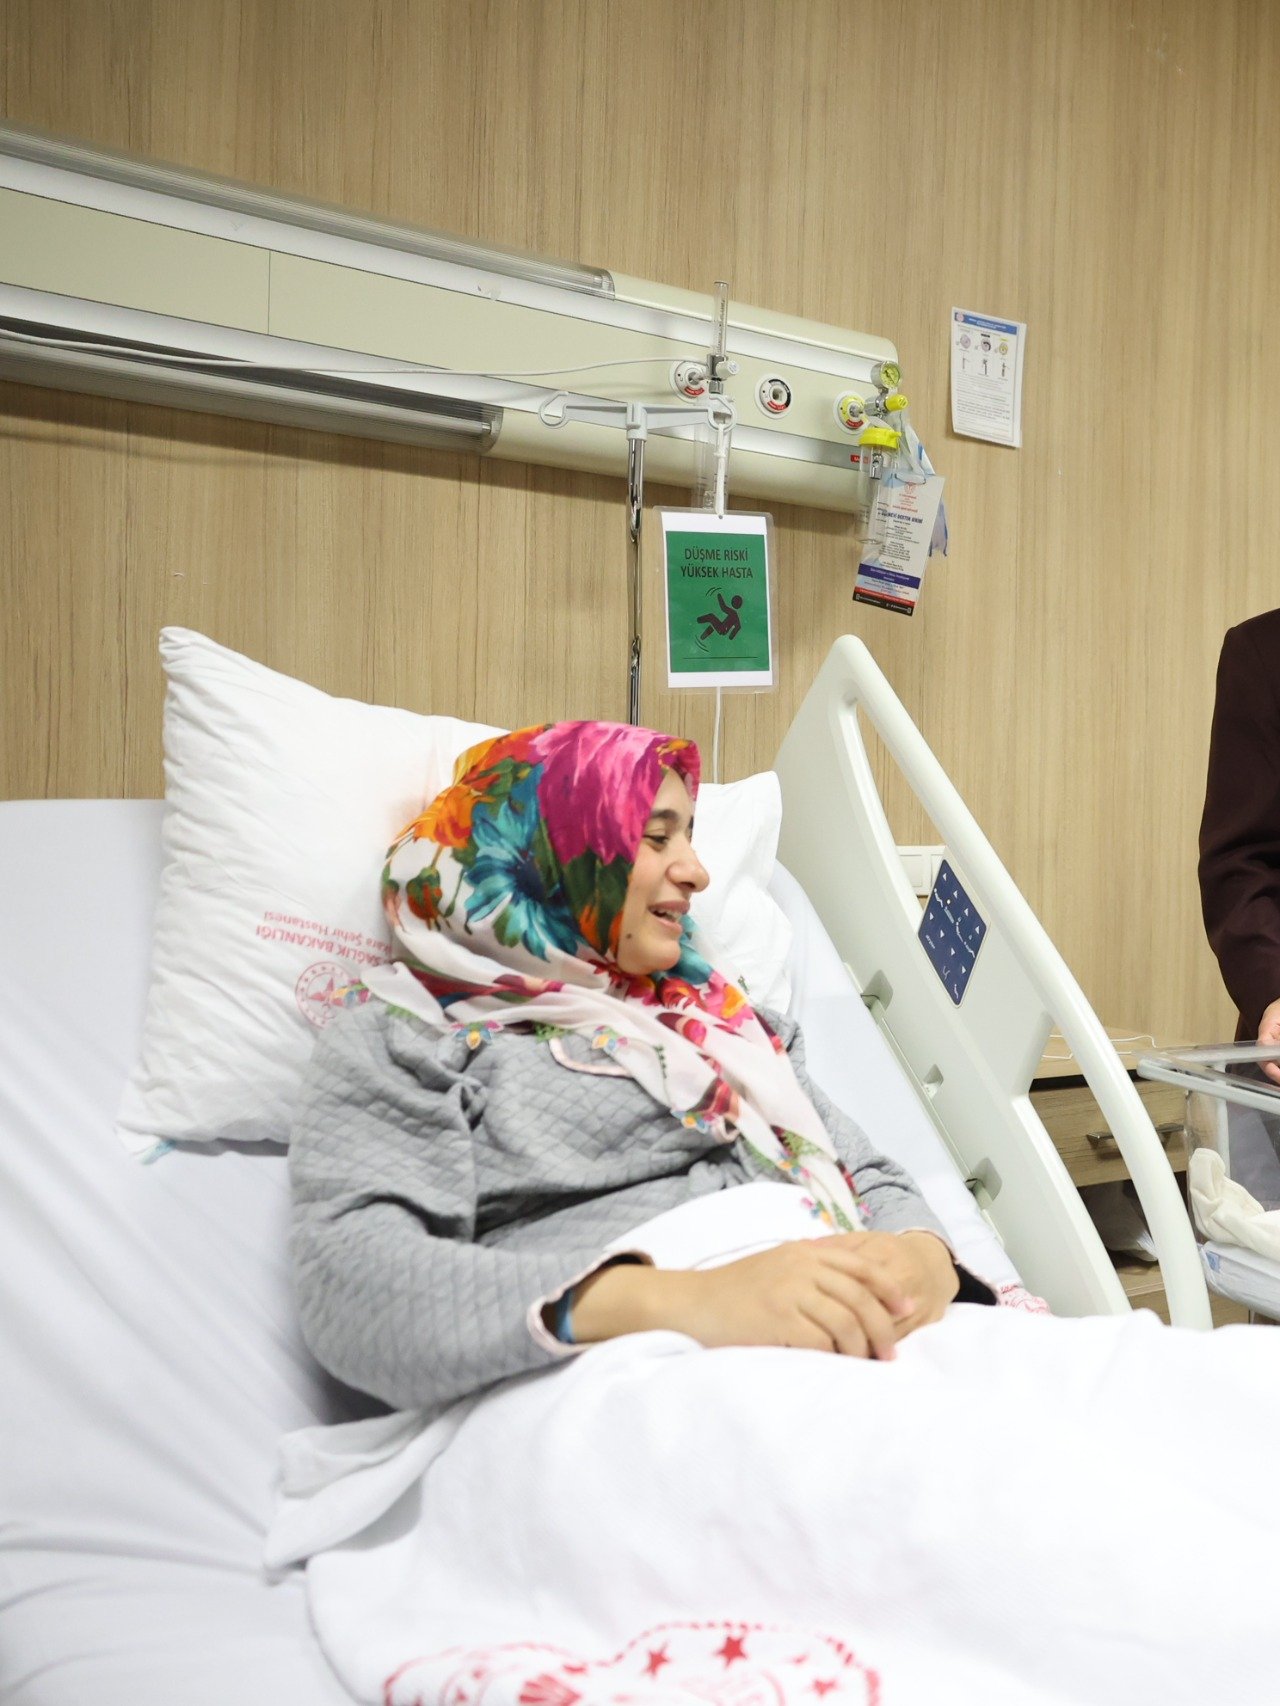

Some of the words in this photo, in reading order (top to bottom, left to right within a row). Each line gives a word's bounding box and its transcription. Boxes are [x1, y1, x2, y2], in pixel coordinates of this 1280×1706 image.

[684, 546, 722, 562] DÜŞME
[724, 547, 749, 561] RİSKİ
[680, 563, 719, 578] YÜKSEK
[723, 567, 753, 579] HASTA
[263, 911, 329, 936] Hastanesi
[255, 925, 335, 953] BAKANLIĞI
[332, 928, 363, 945] Şehir
